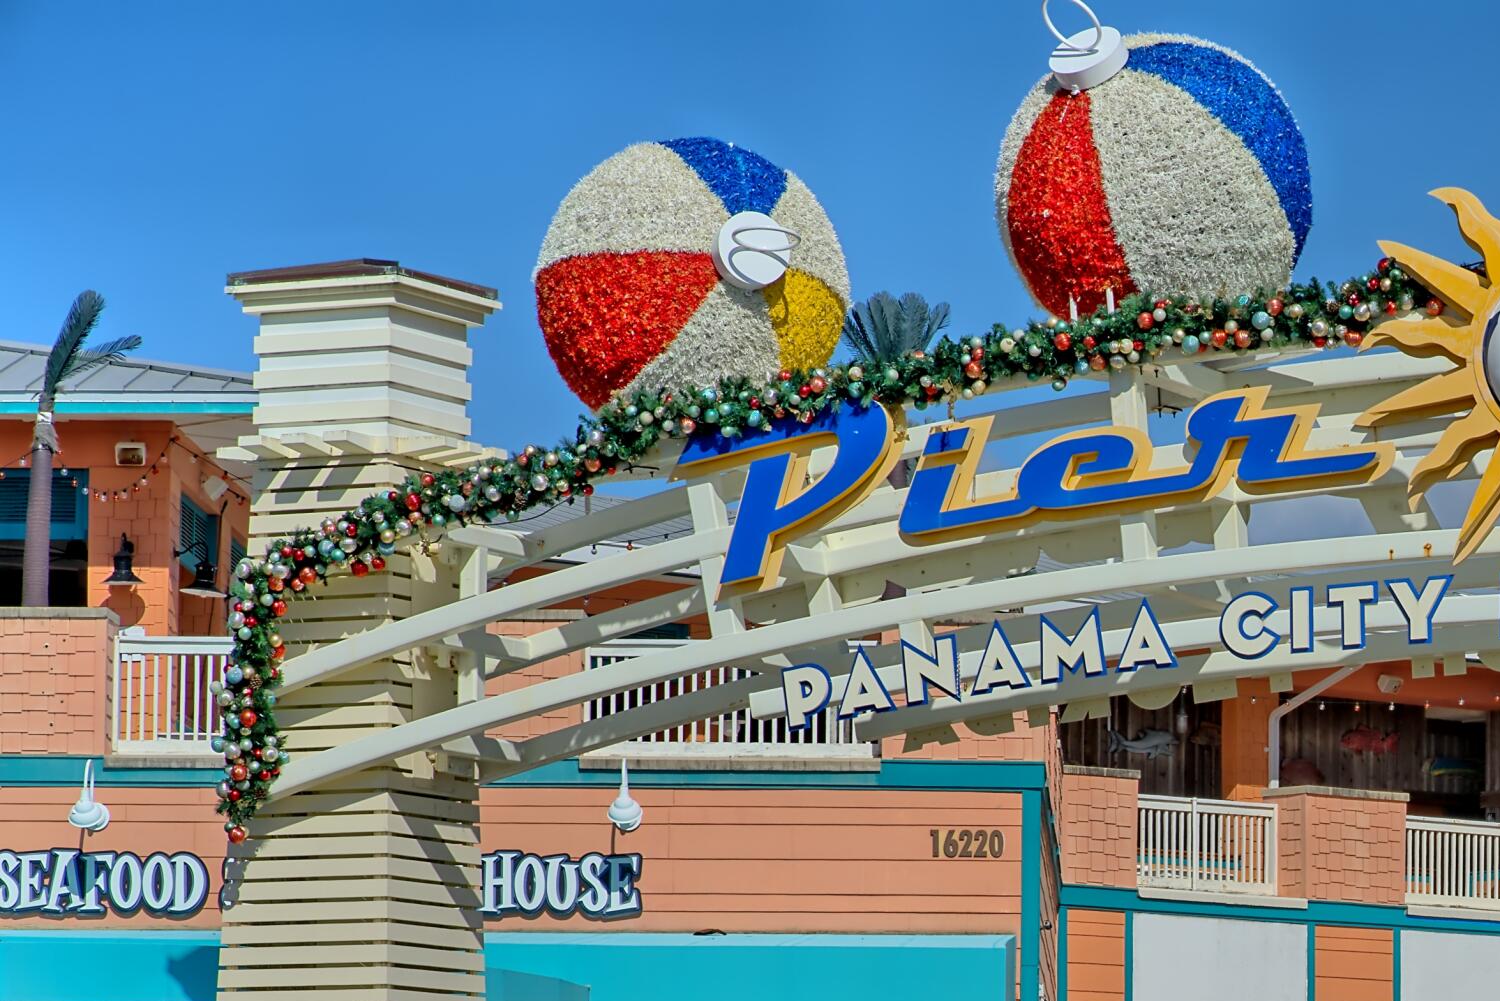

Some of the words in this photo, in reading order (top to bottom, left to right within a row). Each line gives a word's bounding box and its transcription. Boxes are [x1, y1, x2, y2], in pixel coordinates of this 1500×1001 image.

[673, 385, 1396, 599] Pier
[780, 599, 1178, 731] PANAMA
[1219, 573, 1454, 660] CITY
[0, 849, 209, 916] SEAFOOD
[478, 850, 642, 920] HOUSE
[930, 829, 1004, 858] 16220
